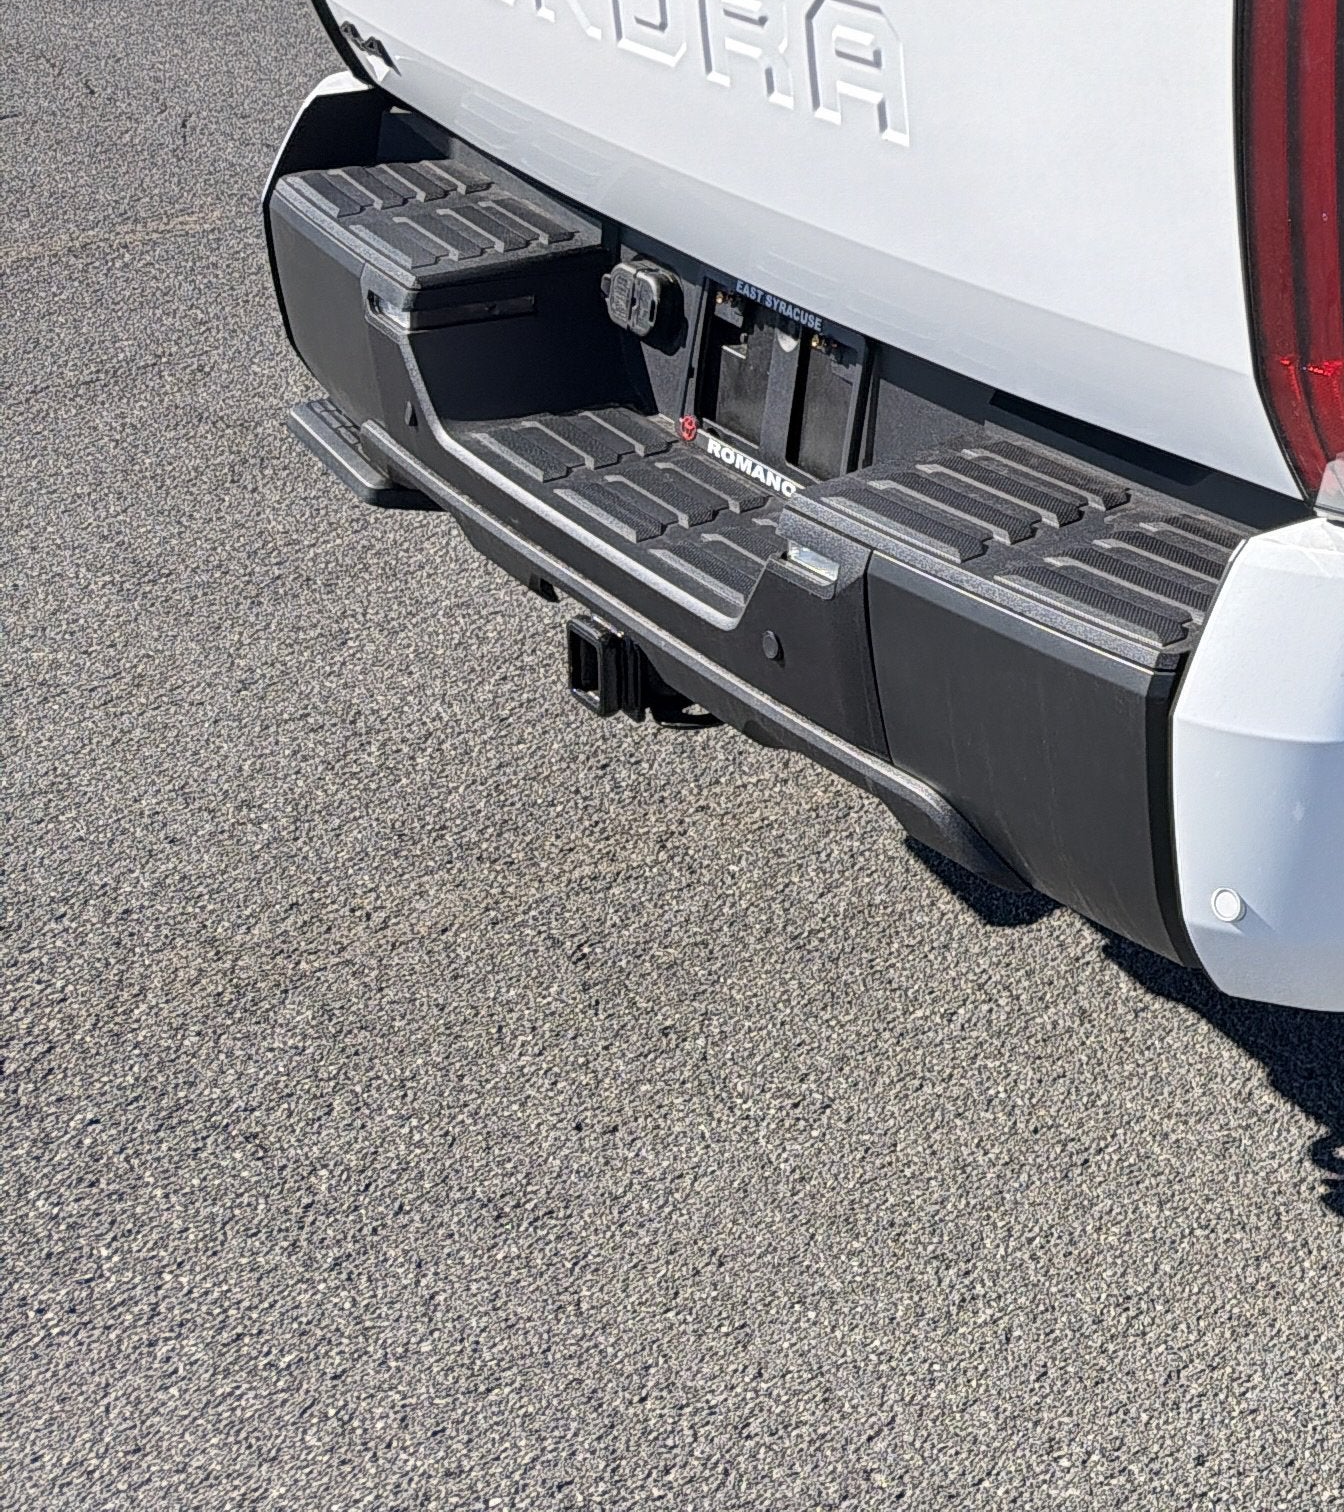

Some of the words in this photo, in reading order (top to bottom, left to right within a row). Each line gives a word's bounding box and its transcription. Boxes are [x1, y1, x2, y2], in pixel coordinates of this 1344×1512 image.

[736, 279, 764, 303] EAST
[765, 294, 823, 332] SYRACUSE
[707, 437, 797, 498] ROMANO
